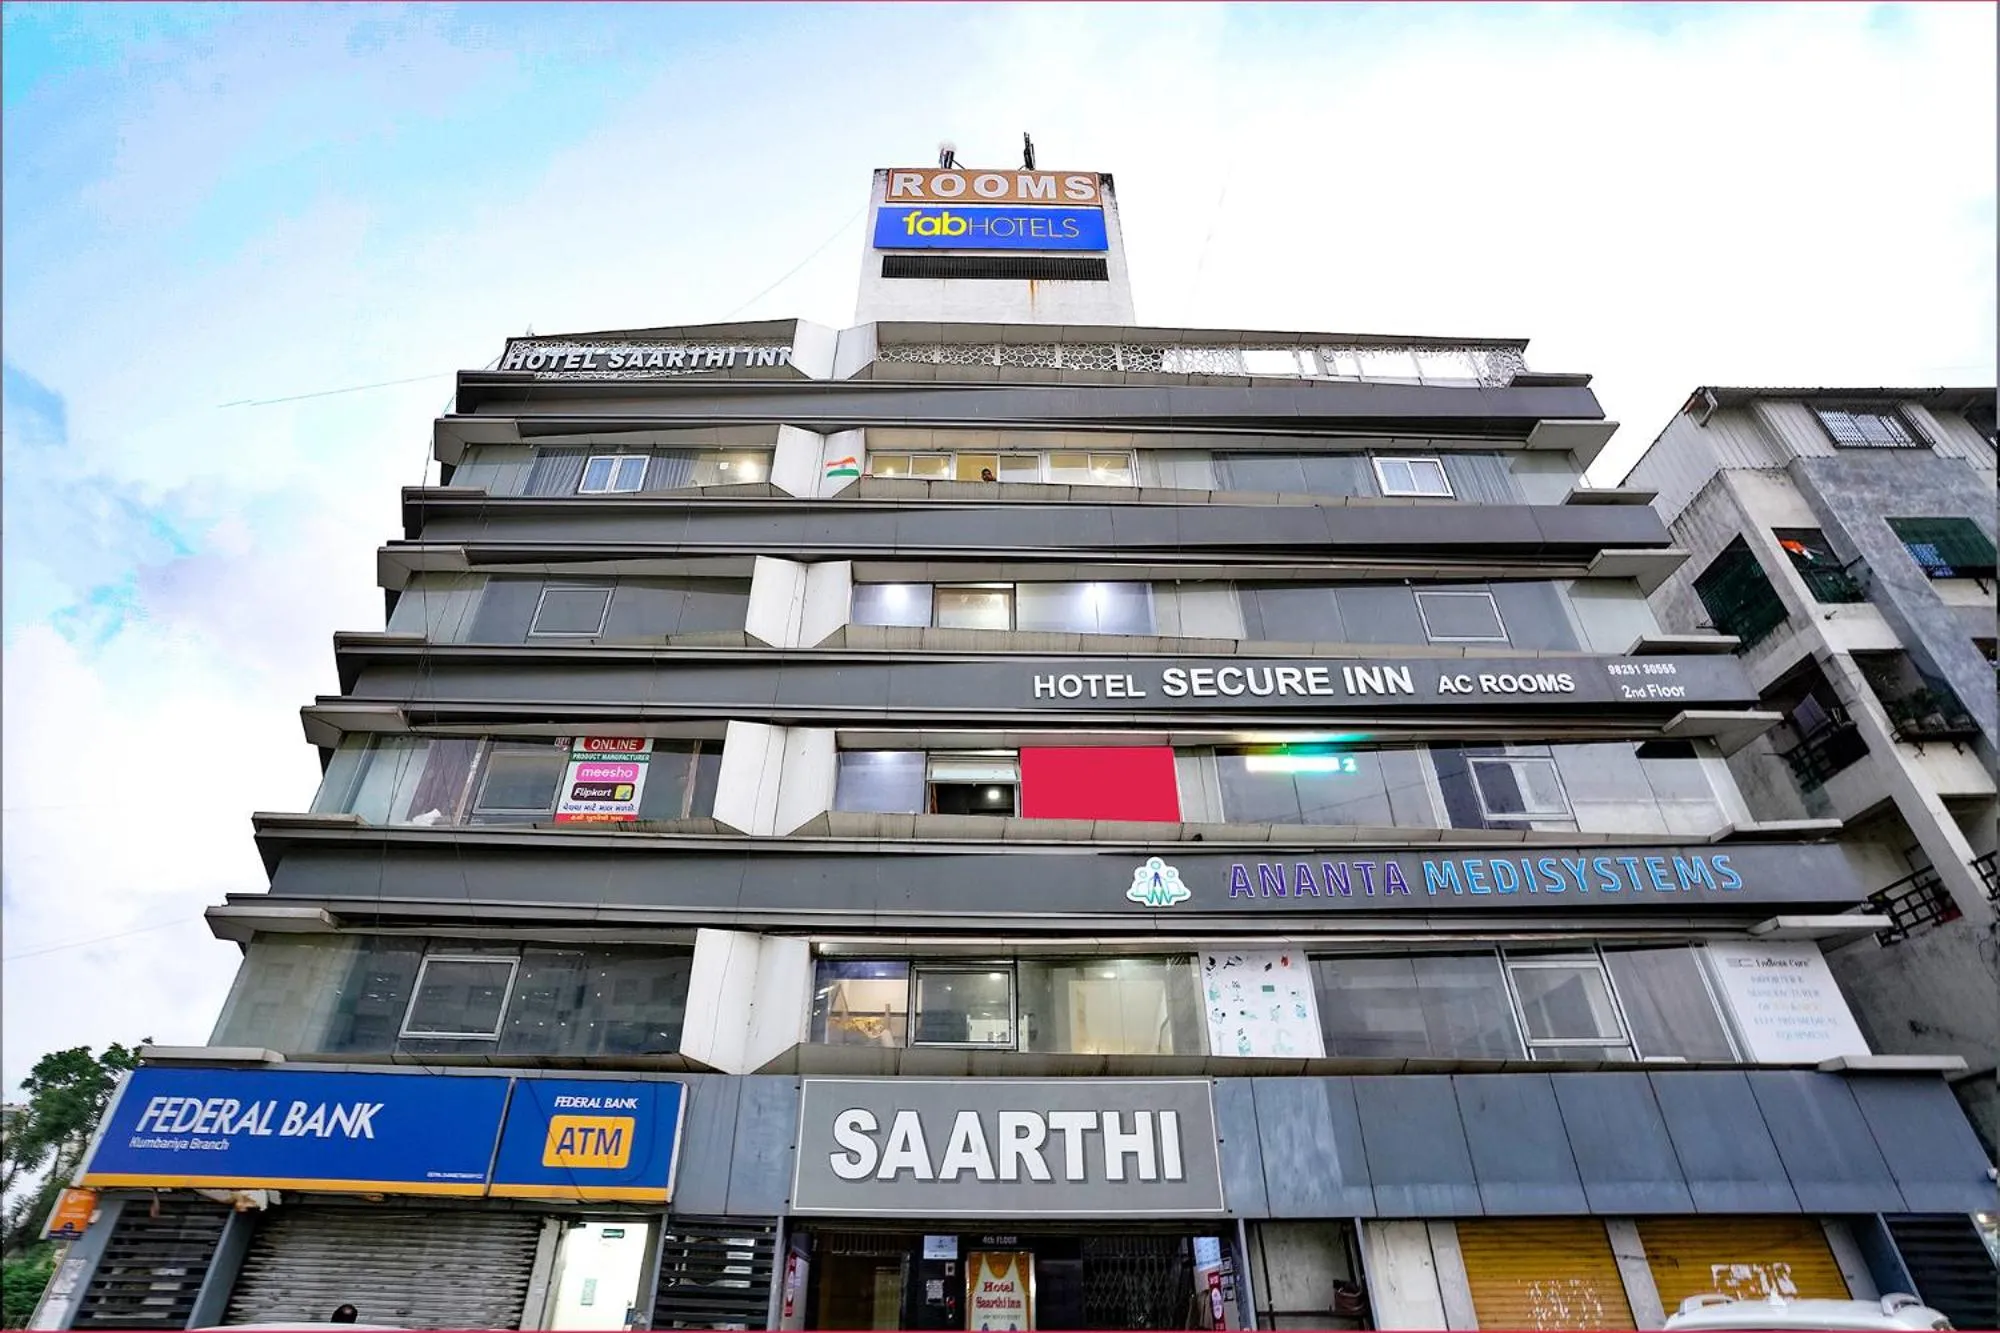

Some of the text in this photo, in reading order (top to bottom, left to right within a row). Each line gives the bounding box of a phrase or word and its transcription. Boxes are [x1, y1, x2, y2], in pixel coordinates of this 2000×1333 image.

[890, 172, 1096, 200] ROOMS
[902, 210, 1080, 239] fabHOTELS
[502, 348, 598, 371] HOTEL
[607, 346, 736, 369] SAARTHI
[1033, 665, 1576, 699] HOTEL SECURE INN AC ROOMS
[1621, 683, 1686, 698] 2nd Floor
[591, 738, 638, 751] ONLINE
[572, 753, 602, 762] PRODUCT
[581, 766, 633, 779] meesho
[573, 787, 612, 800] Flipkart
[1228, 854, 1744, 898] ANANTA MEDISYSTEMS
[554, 1096, 640, 1110] FEDERAL BANK
[136, 1096, 385, 1140] FEDERAL BANK
[189, 1138, 230, 1151] Branch
[555, 1126, 623, 1157] ATM
[829, 1107, 1186, 1183] SAARTHI
[983, 1281, 1015, 1293] Hotel
